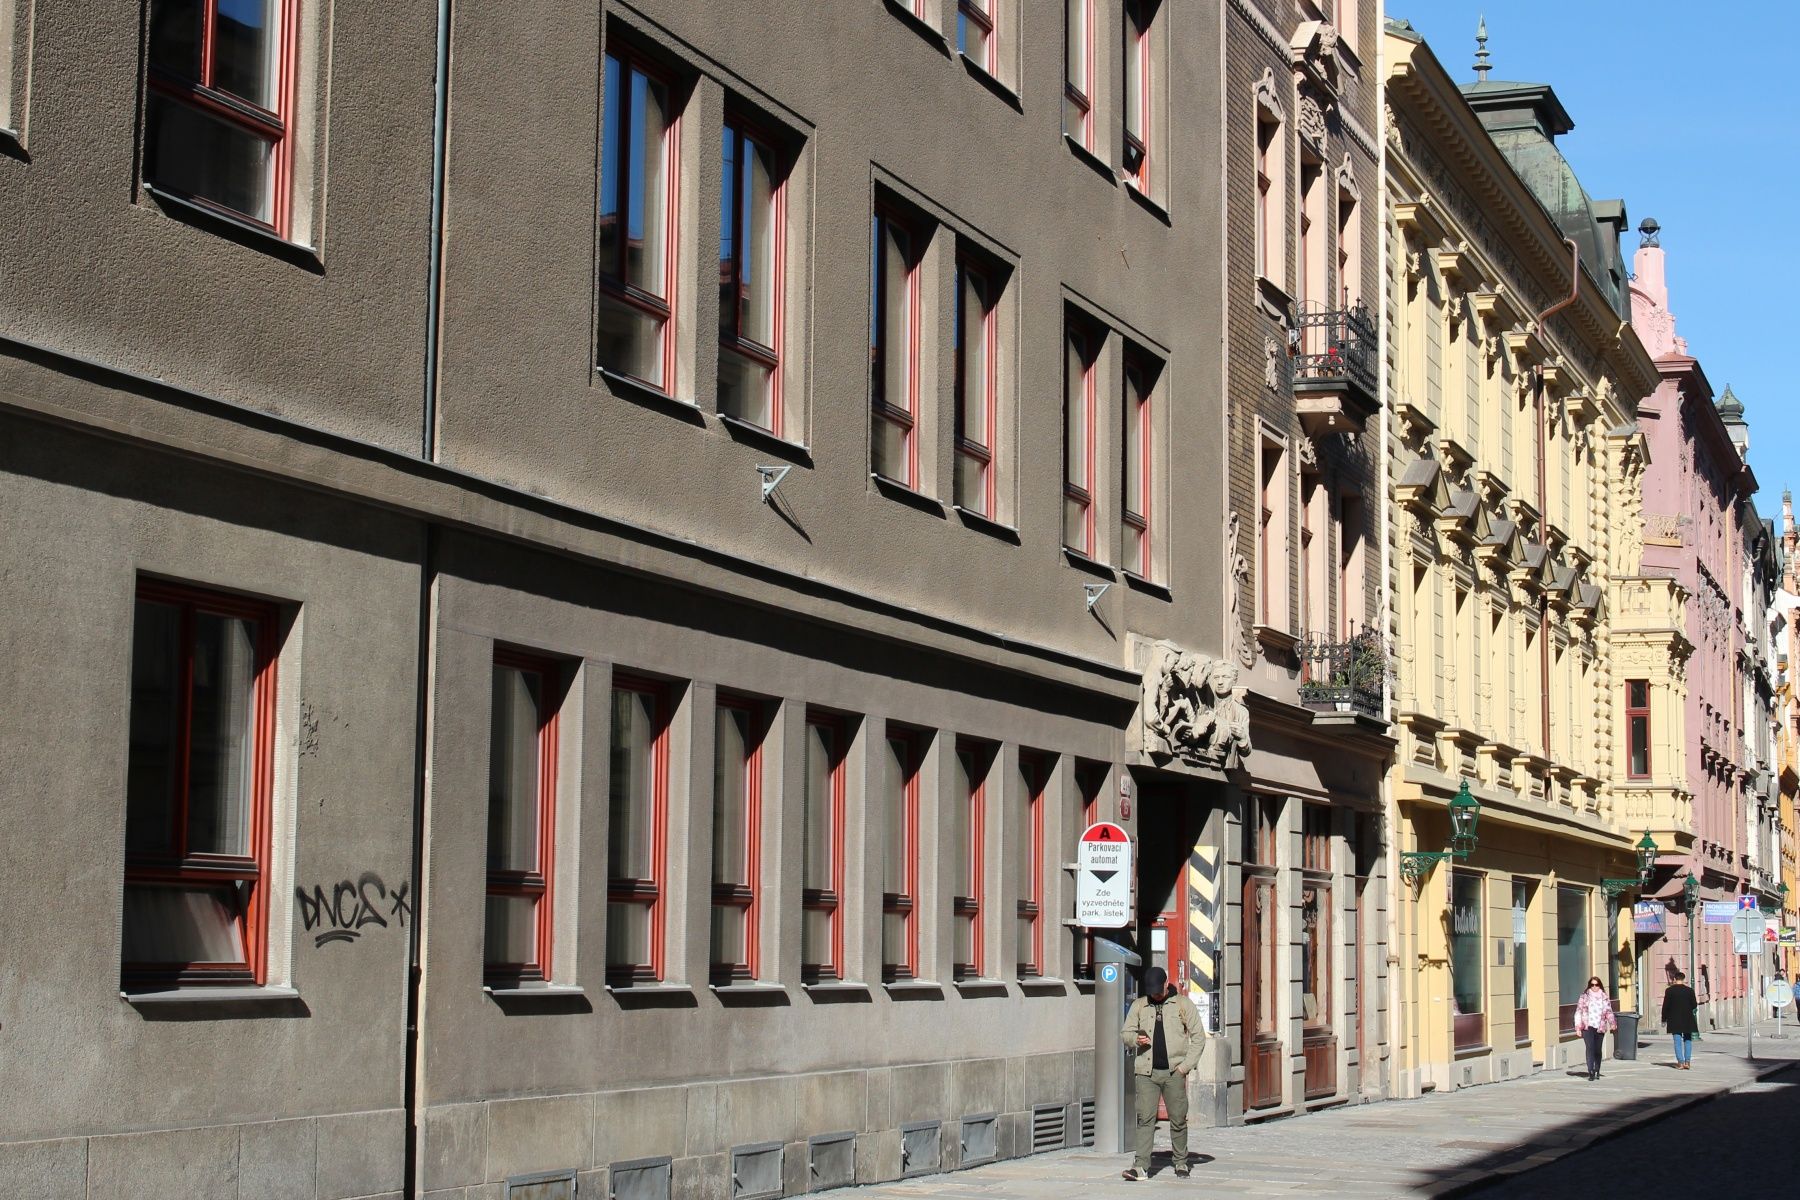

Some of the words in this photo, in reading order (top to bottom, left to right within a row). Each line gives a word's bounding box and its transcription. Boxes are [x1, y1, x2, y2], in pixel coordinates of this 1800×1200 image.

[1099, 827, 1111, 840] A
[1090, 856, 1118, 865] automat
[1095, 889, 1111, 897] Zde
[1082, 899, 1125, 907] vyzvedněte
[1105, 968, 1113, 979] P
